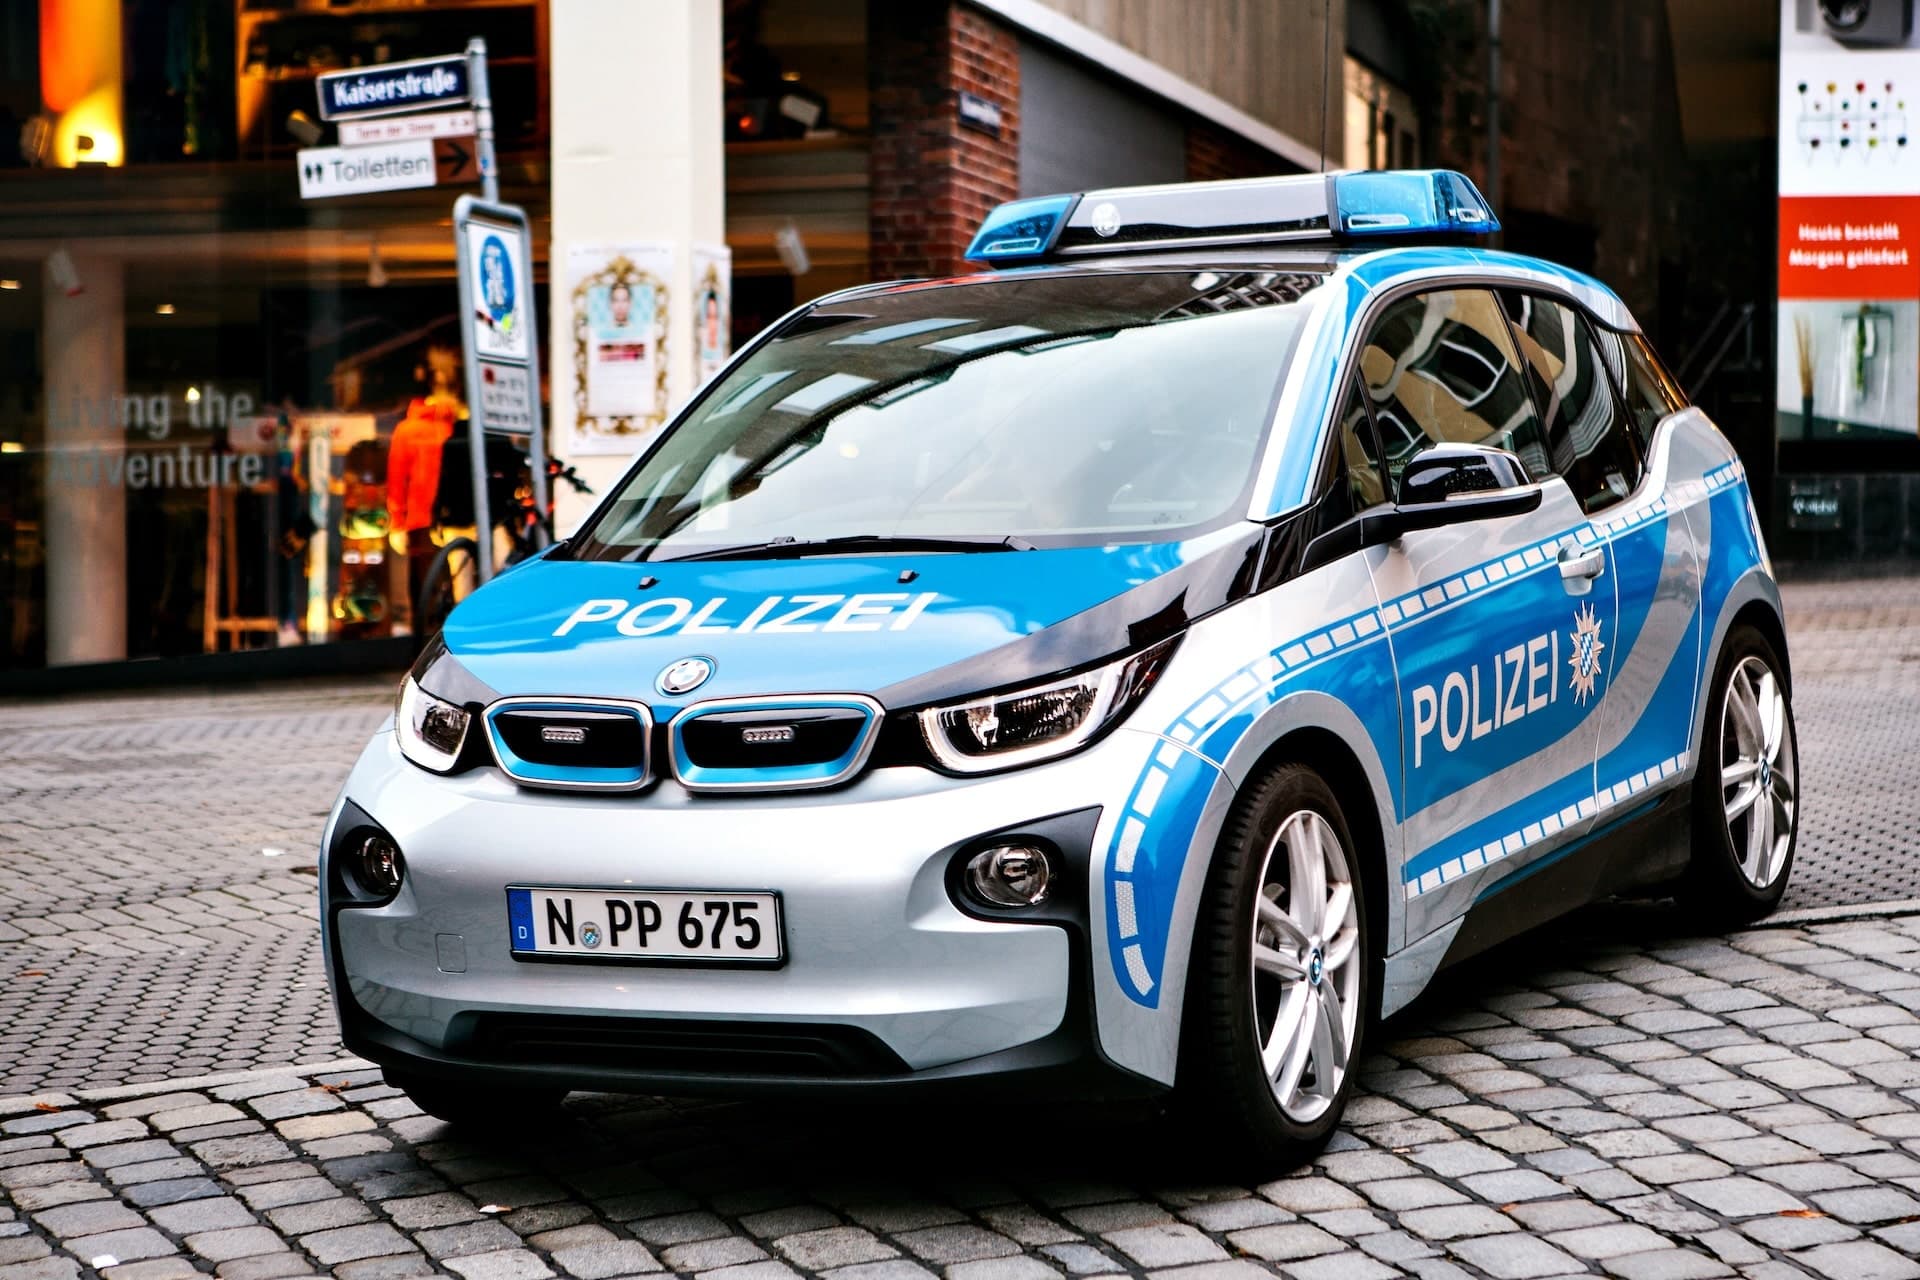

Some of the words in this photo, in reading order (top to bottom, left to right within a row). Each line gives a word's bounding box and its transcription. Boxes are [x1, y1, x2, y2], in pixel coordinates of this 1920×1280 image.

[333, 67, 457, 107] Kaiserstraße
[330, 153, 432, 183] Toiletten
[1798, 223, 1842, 241] Heute
[1845, 222, 1899, 241] bestellt
[1788, 248, 1845, 270] Morgen
[1846, 247, 1908, 270] geliefert
[49, 383, 171, 440] Living
[187, 385, 255, 430] the
[49, 442, 264, 488] Adventure
[551, 592, 939, 637] POLIZEI
[1412, 630, 1559, 769] POLIZEI
[518, 925, 528, 940] D
[546, 898, 575, 946] N
[605, 899, 662, 948] PP
[678, 901, 761, 949] 675
